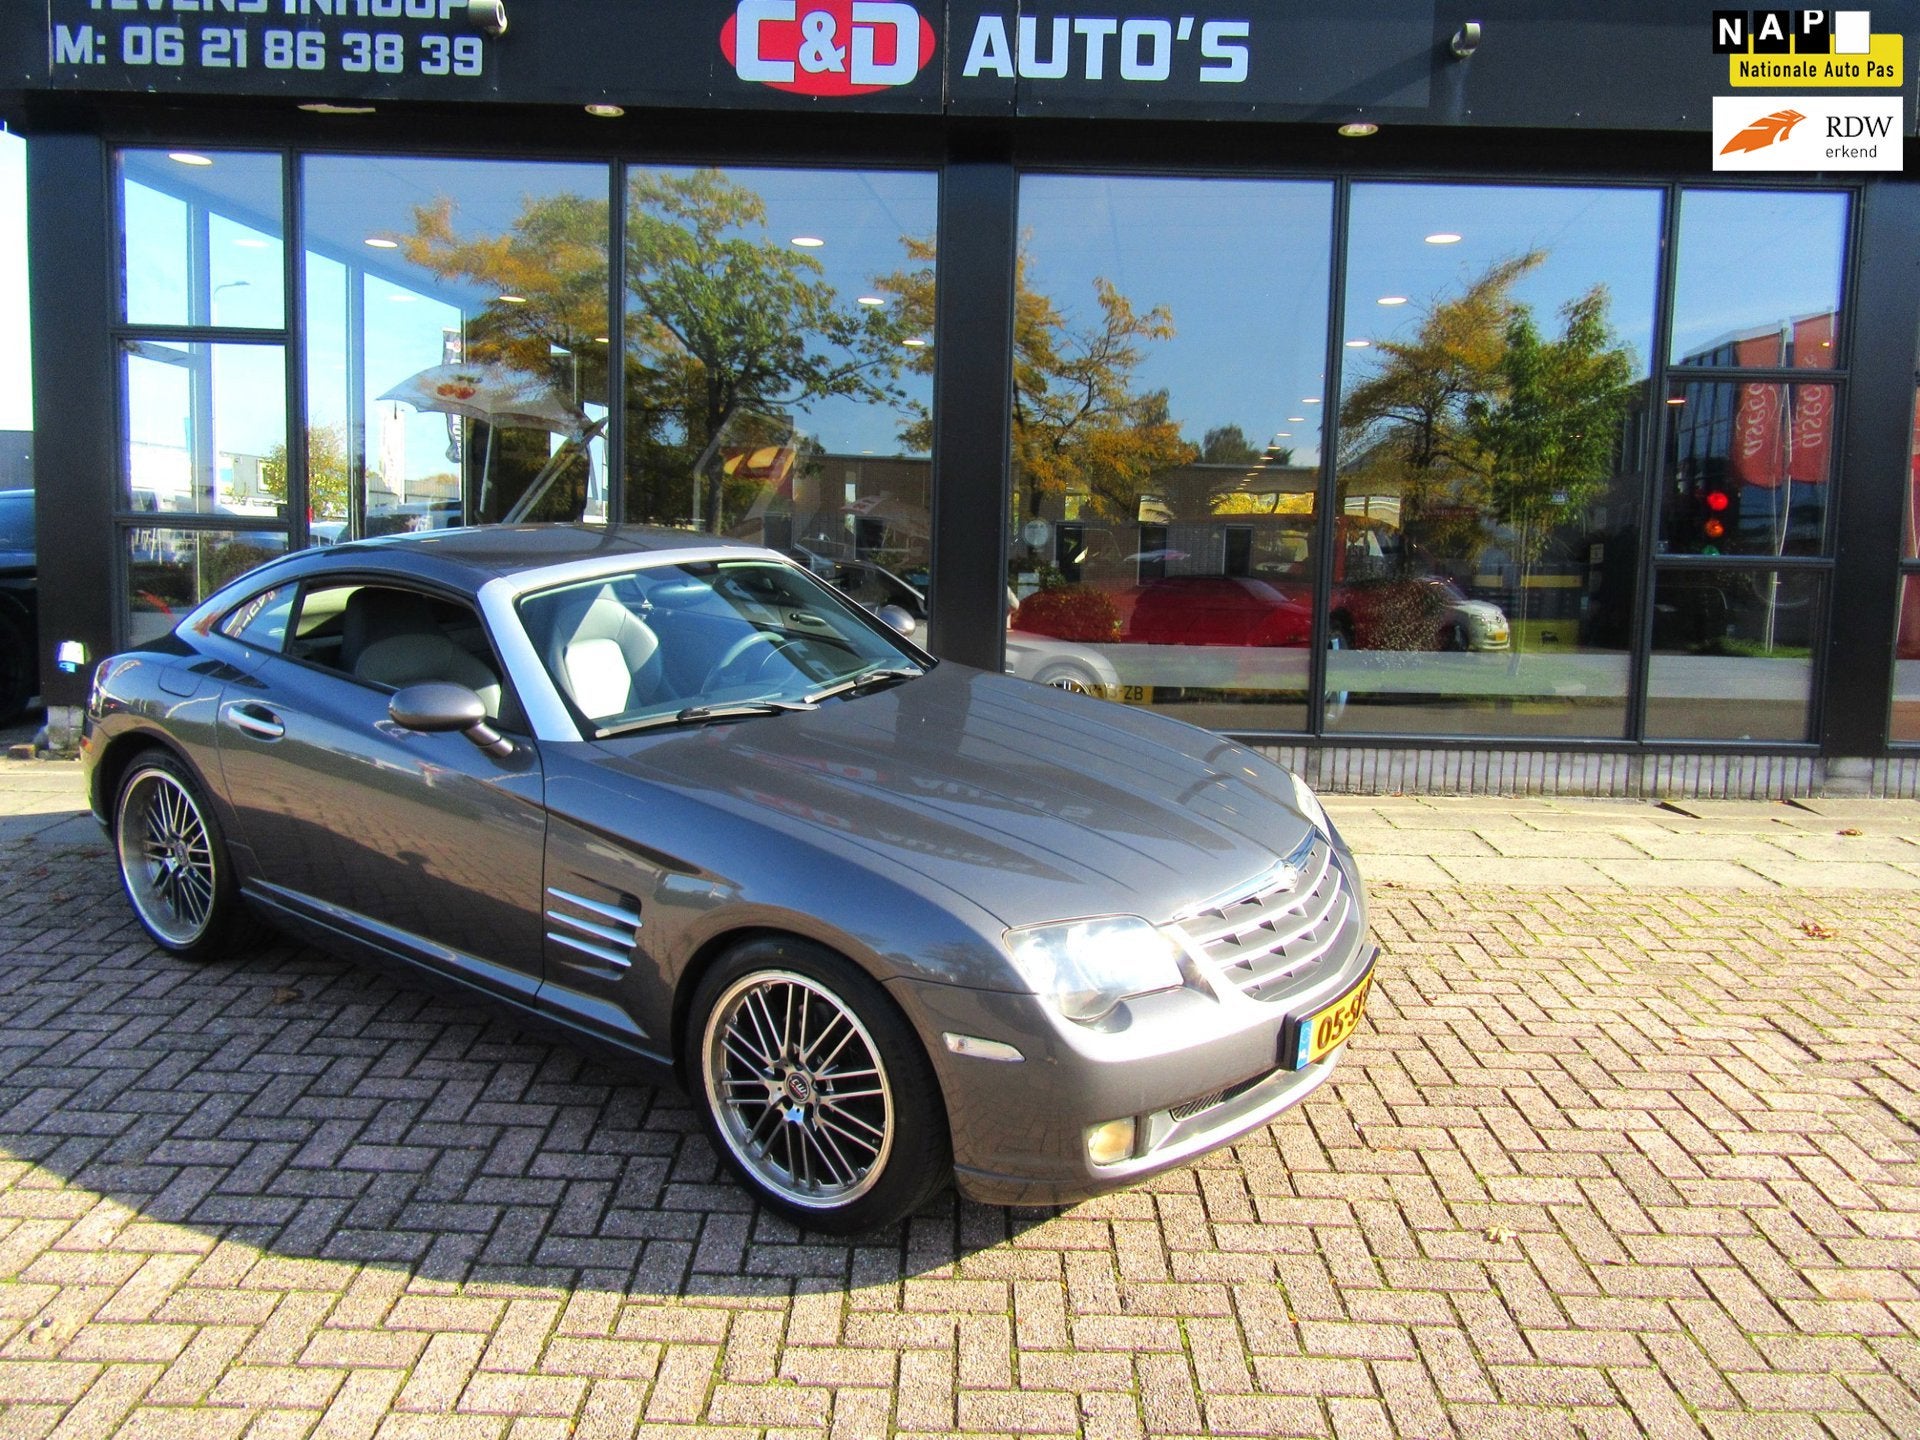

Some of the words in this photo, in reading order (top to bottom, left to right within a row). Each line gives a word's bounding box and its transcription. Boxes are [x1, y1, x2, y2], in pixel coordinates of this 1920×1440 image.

[55, 25, 106, 64] M:
[123, 26, 184, 66] 06
[201, 28, 247, 68] 21
[264, 30, 326, 70] 86
[342, 33, 404, 73] 38
[421, 35, 483, 76] 39
[735, 0, 920, 86] C&D
[962, 16, 1250, 83] AUTO'S
